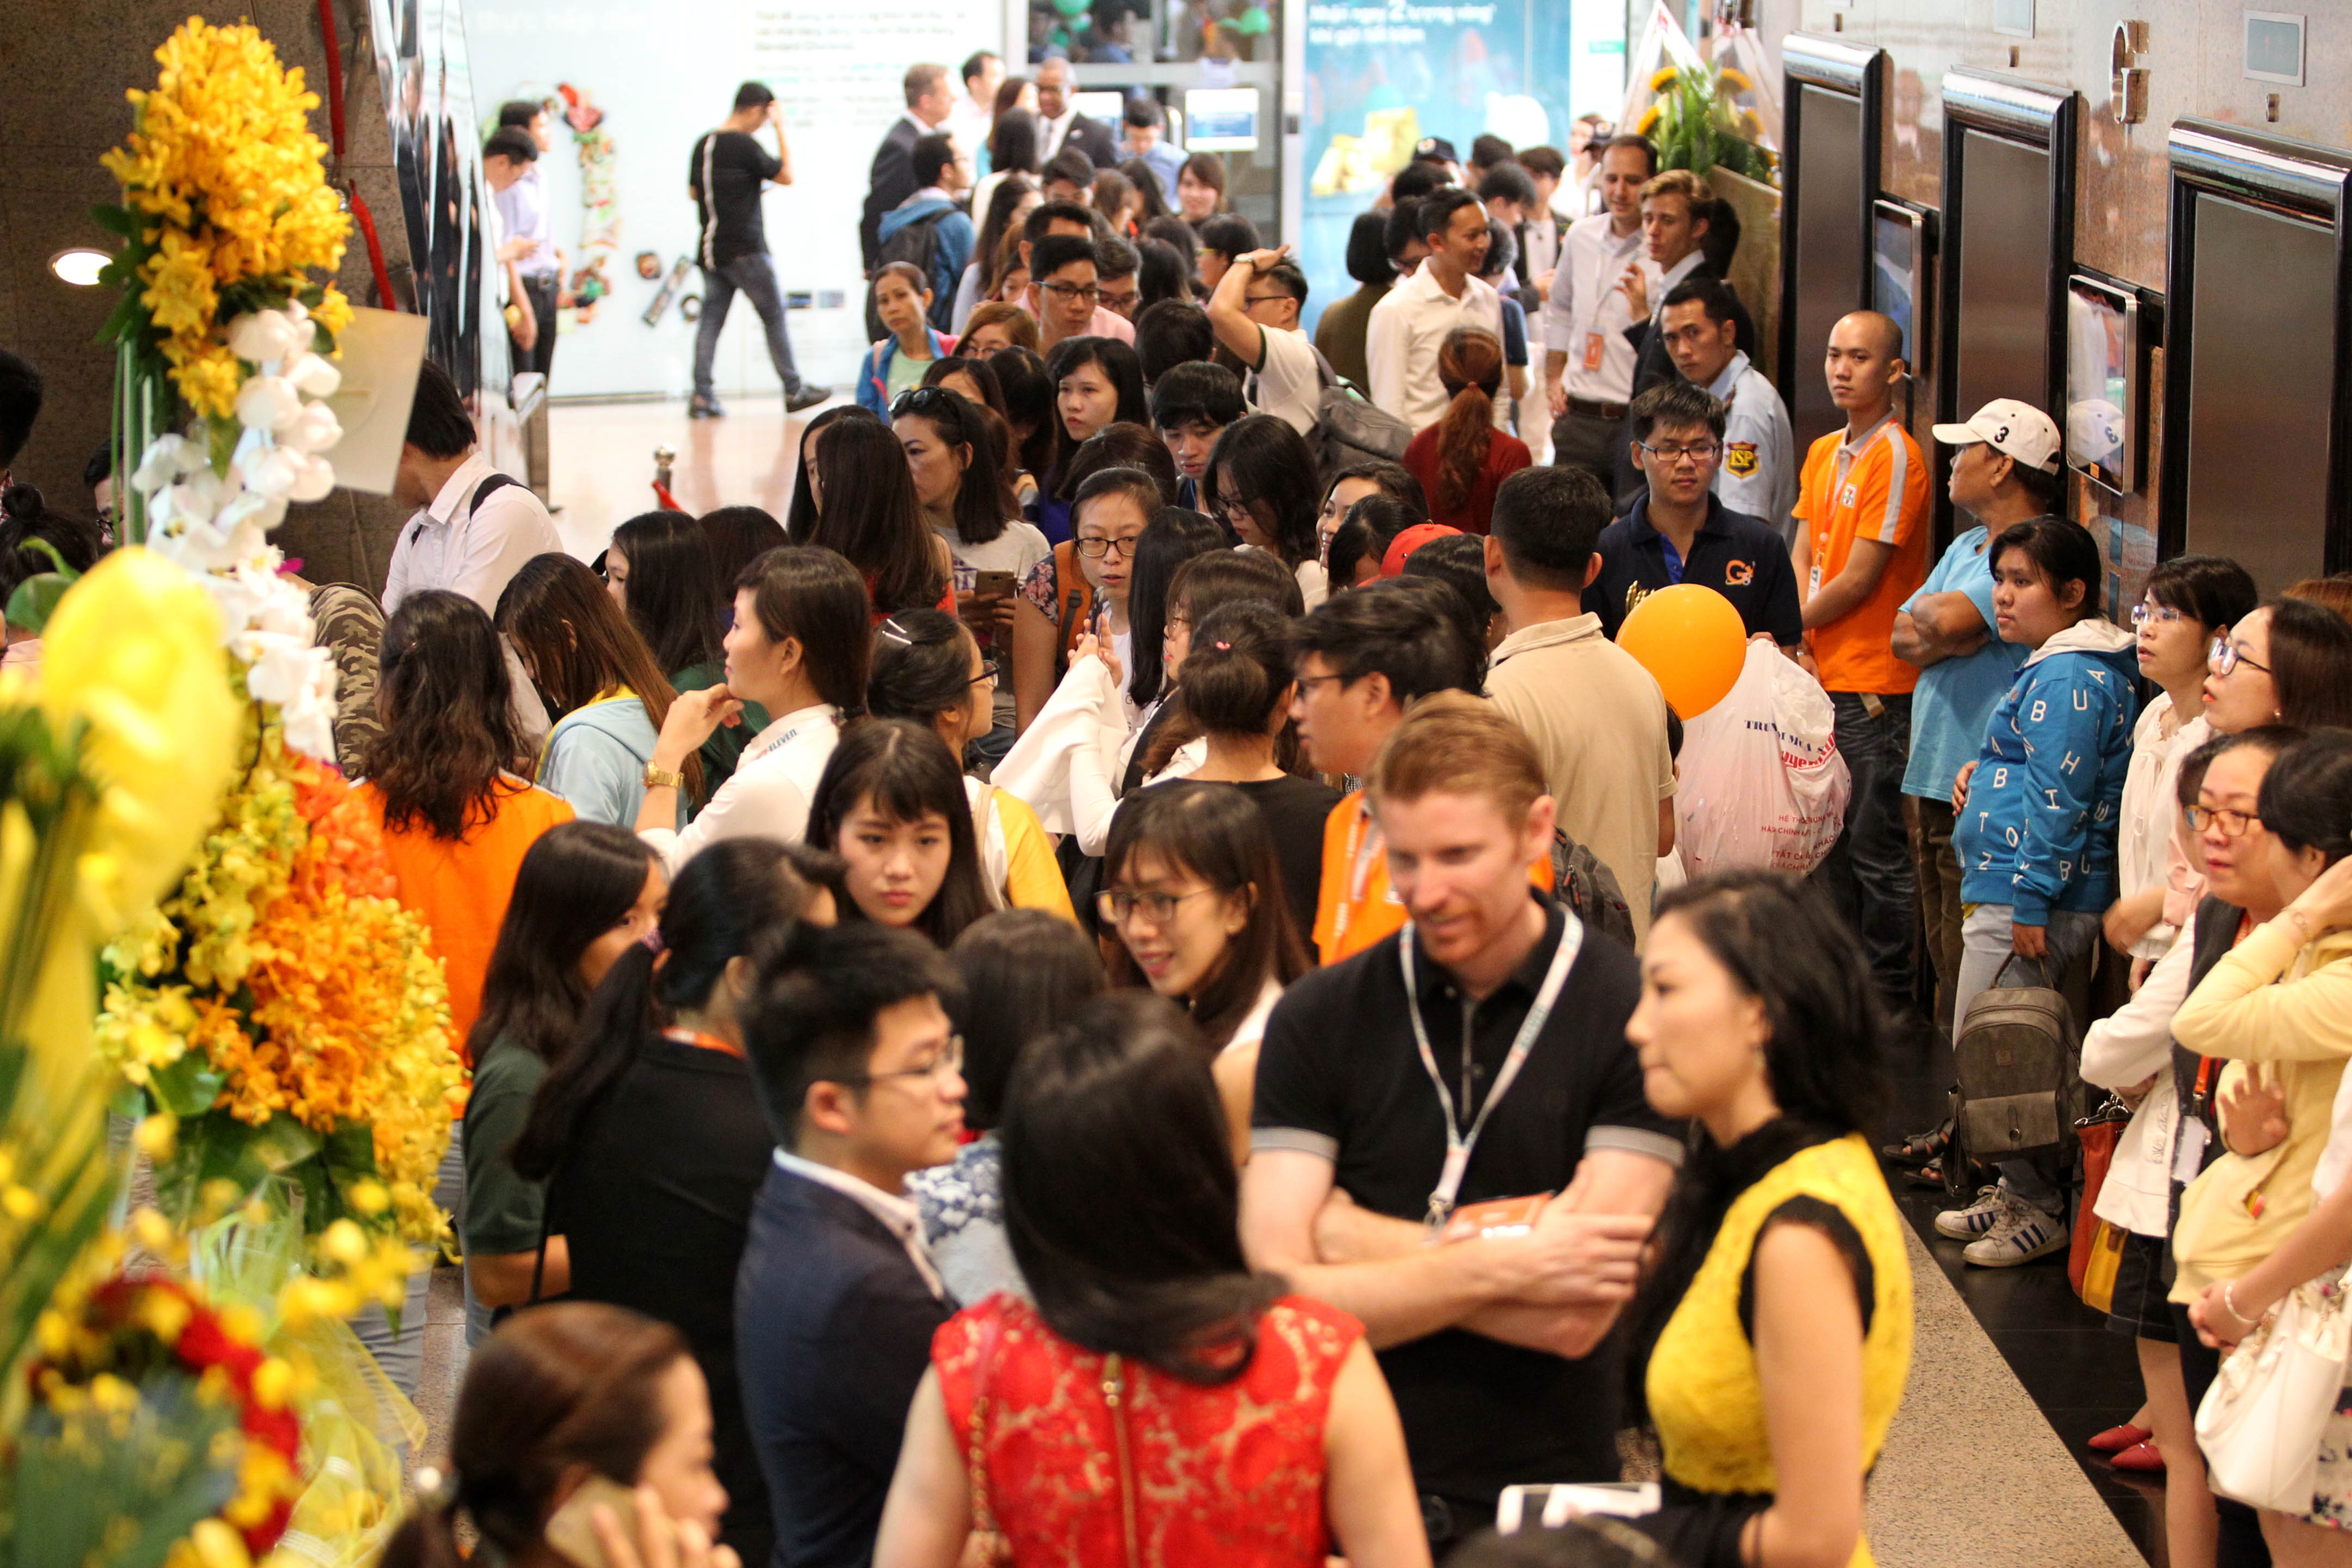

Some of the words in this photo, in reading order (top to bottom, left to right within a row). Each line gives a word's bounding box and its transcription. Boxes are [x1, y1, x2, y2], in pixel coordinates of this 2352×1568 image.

[1994, 426, 2009, 443] 3
[1730, 450, 1754, 467] ISP
[2073, 688, 2088, 710] U
[2030, 699, 2047, 722] B
[1744, 719, 1778, 732] TRUN
[2060, 750, 2081, 775] H
[1993, 768, 2008, 788] B
[2044, 788, 2061, 810] I
[1979, 811, 1989, 834] T
